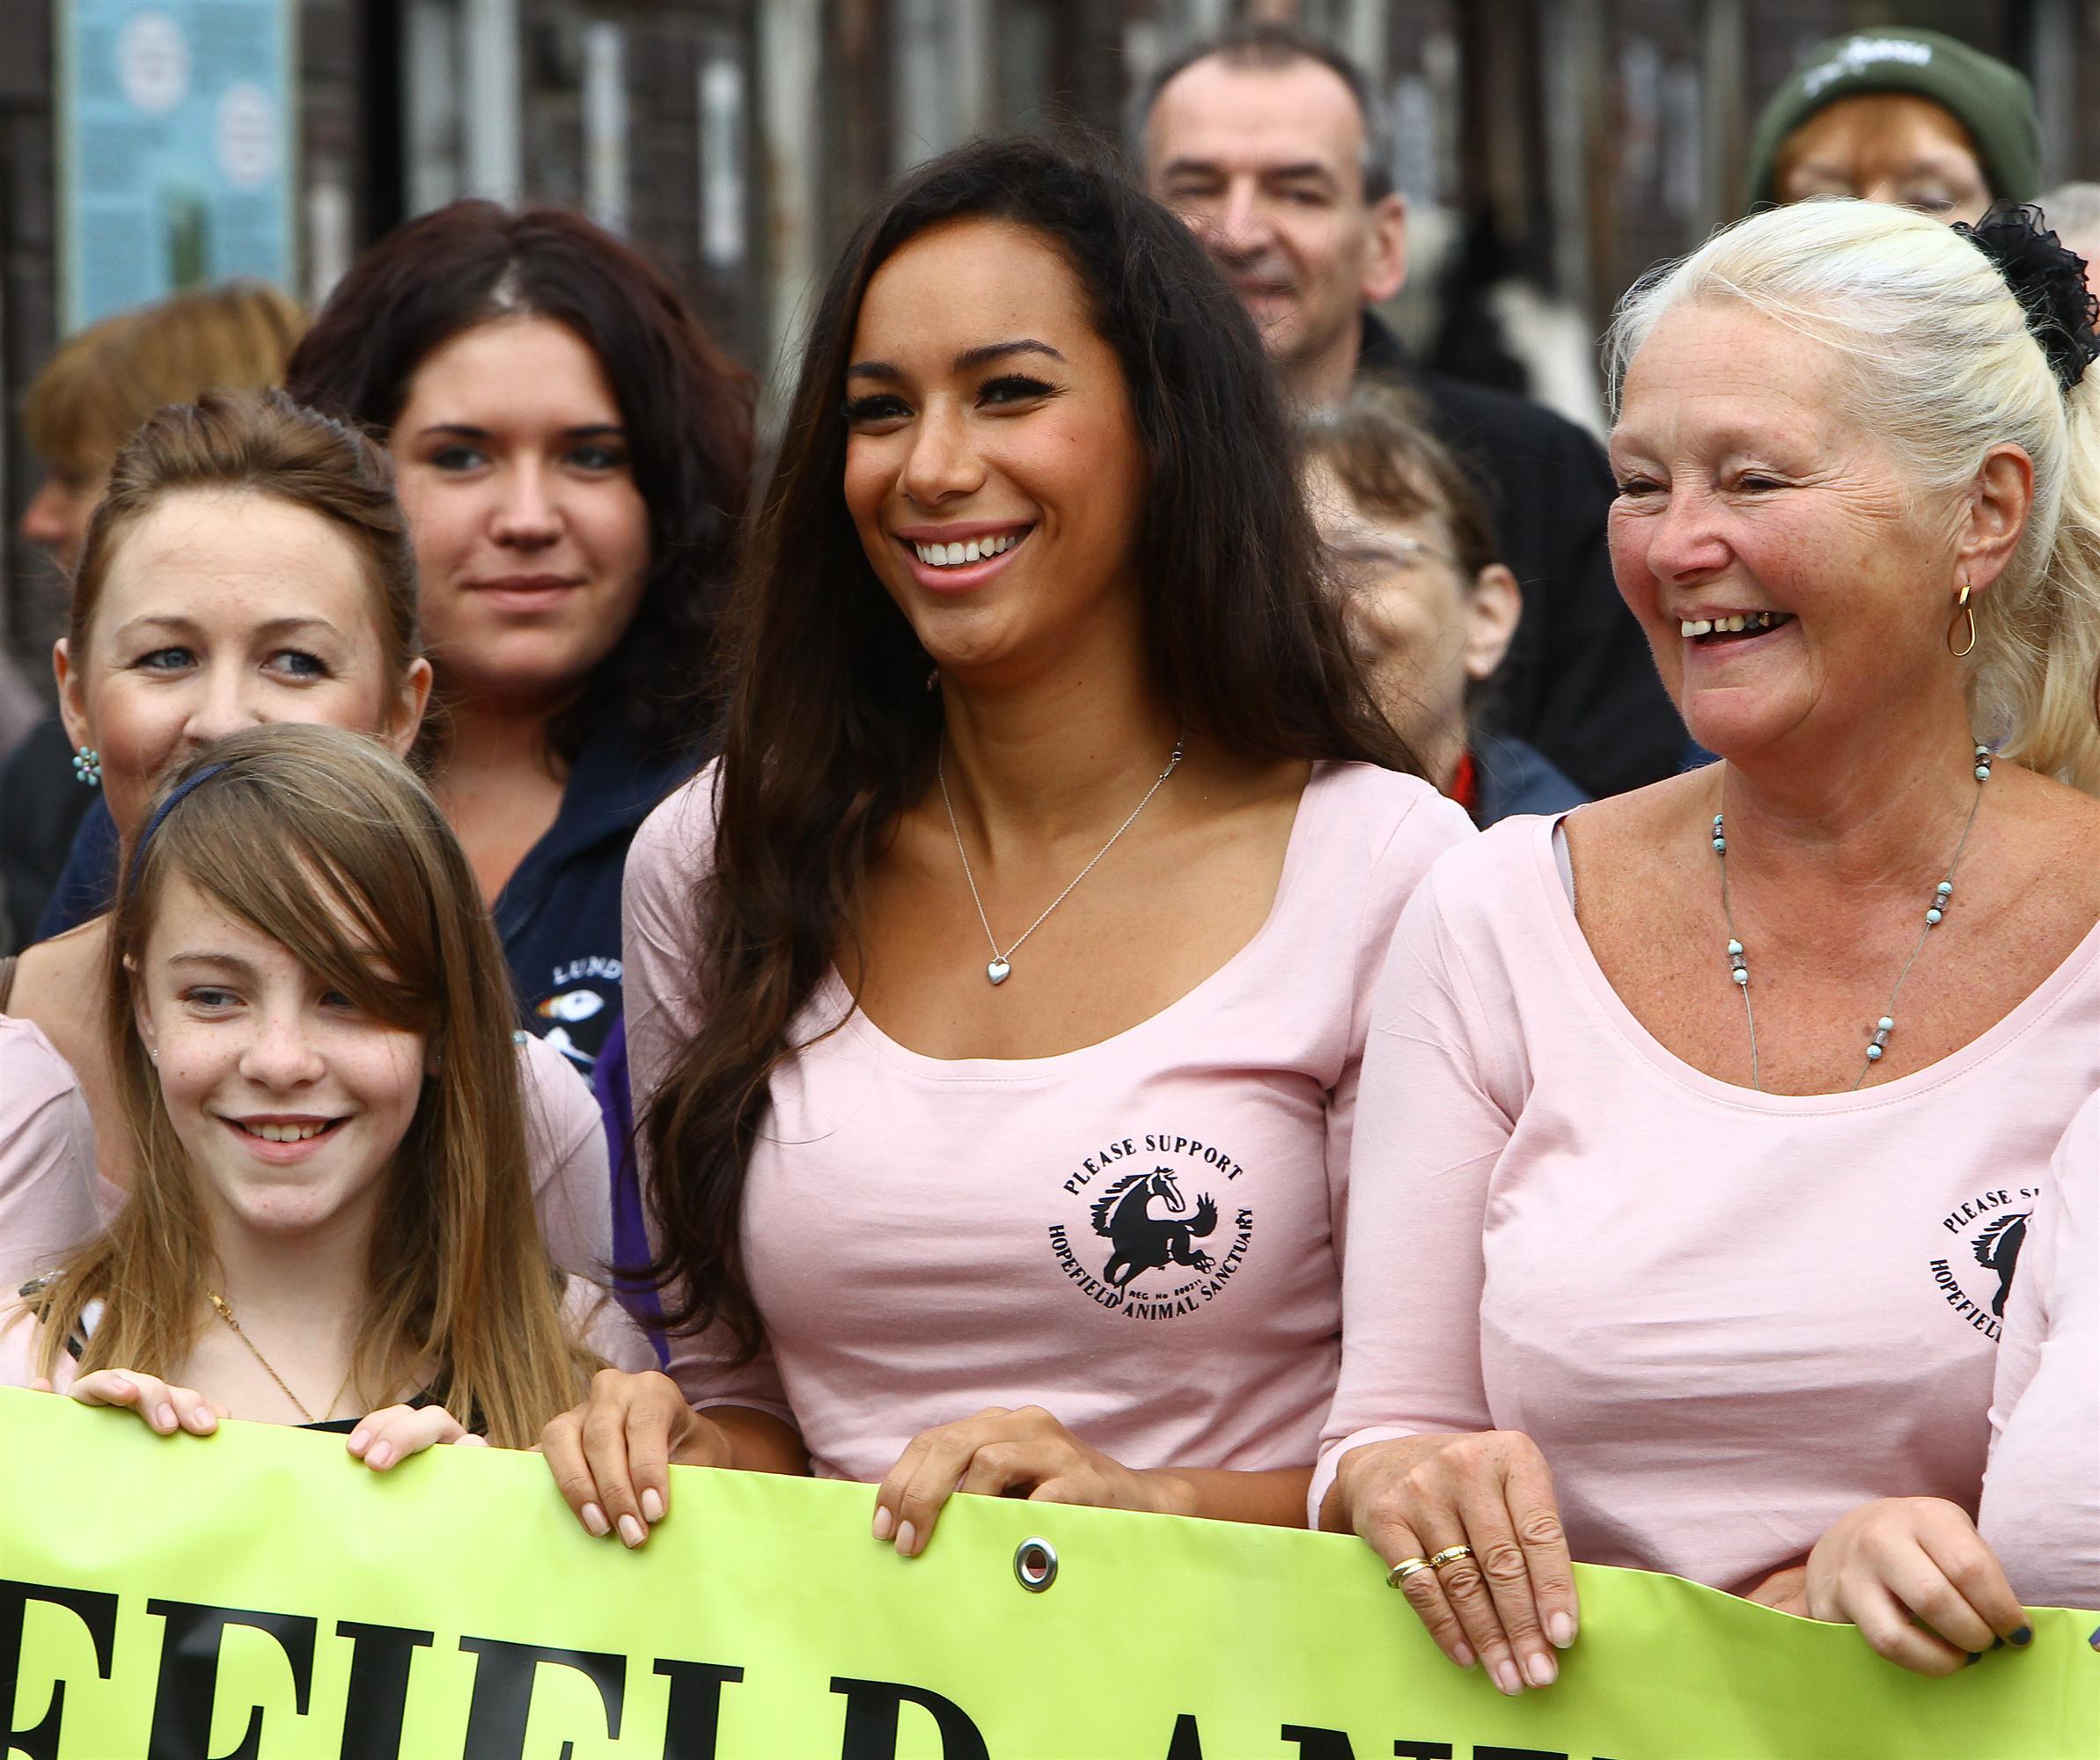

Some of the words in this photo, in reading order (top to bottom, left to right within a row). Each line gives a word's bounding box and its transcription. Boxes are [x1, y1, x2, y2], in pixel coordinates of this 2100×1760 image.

[553, 955, 622, 986] LUND
[1063, 1138, 1136, 1195] PLEASE
[1145, 1134, 1243, 1181] SUPPORT
[1942, 1190, 2013, 1234] PLEASE
[1048, 1224, 1123, 1309] HOPEFIELD
[1121, 1296, 1200, 1320] ANIMAL
[1201, 1208, 1253, 1302] SANCTUARY
